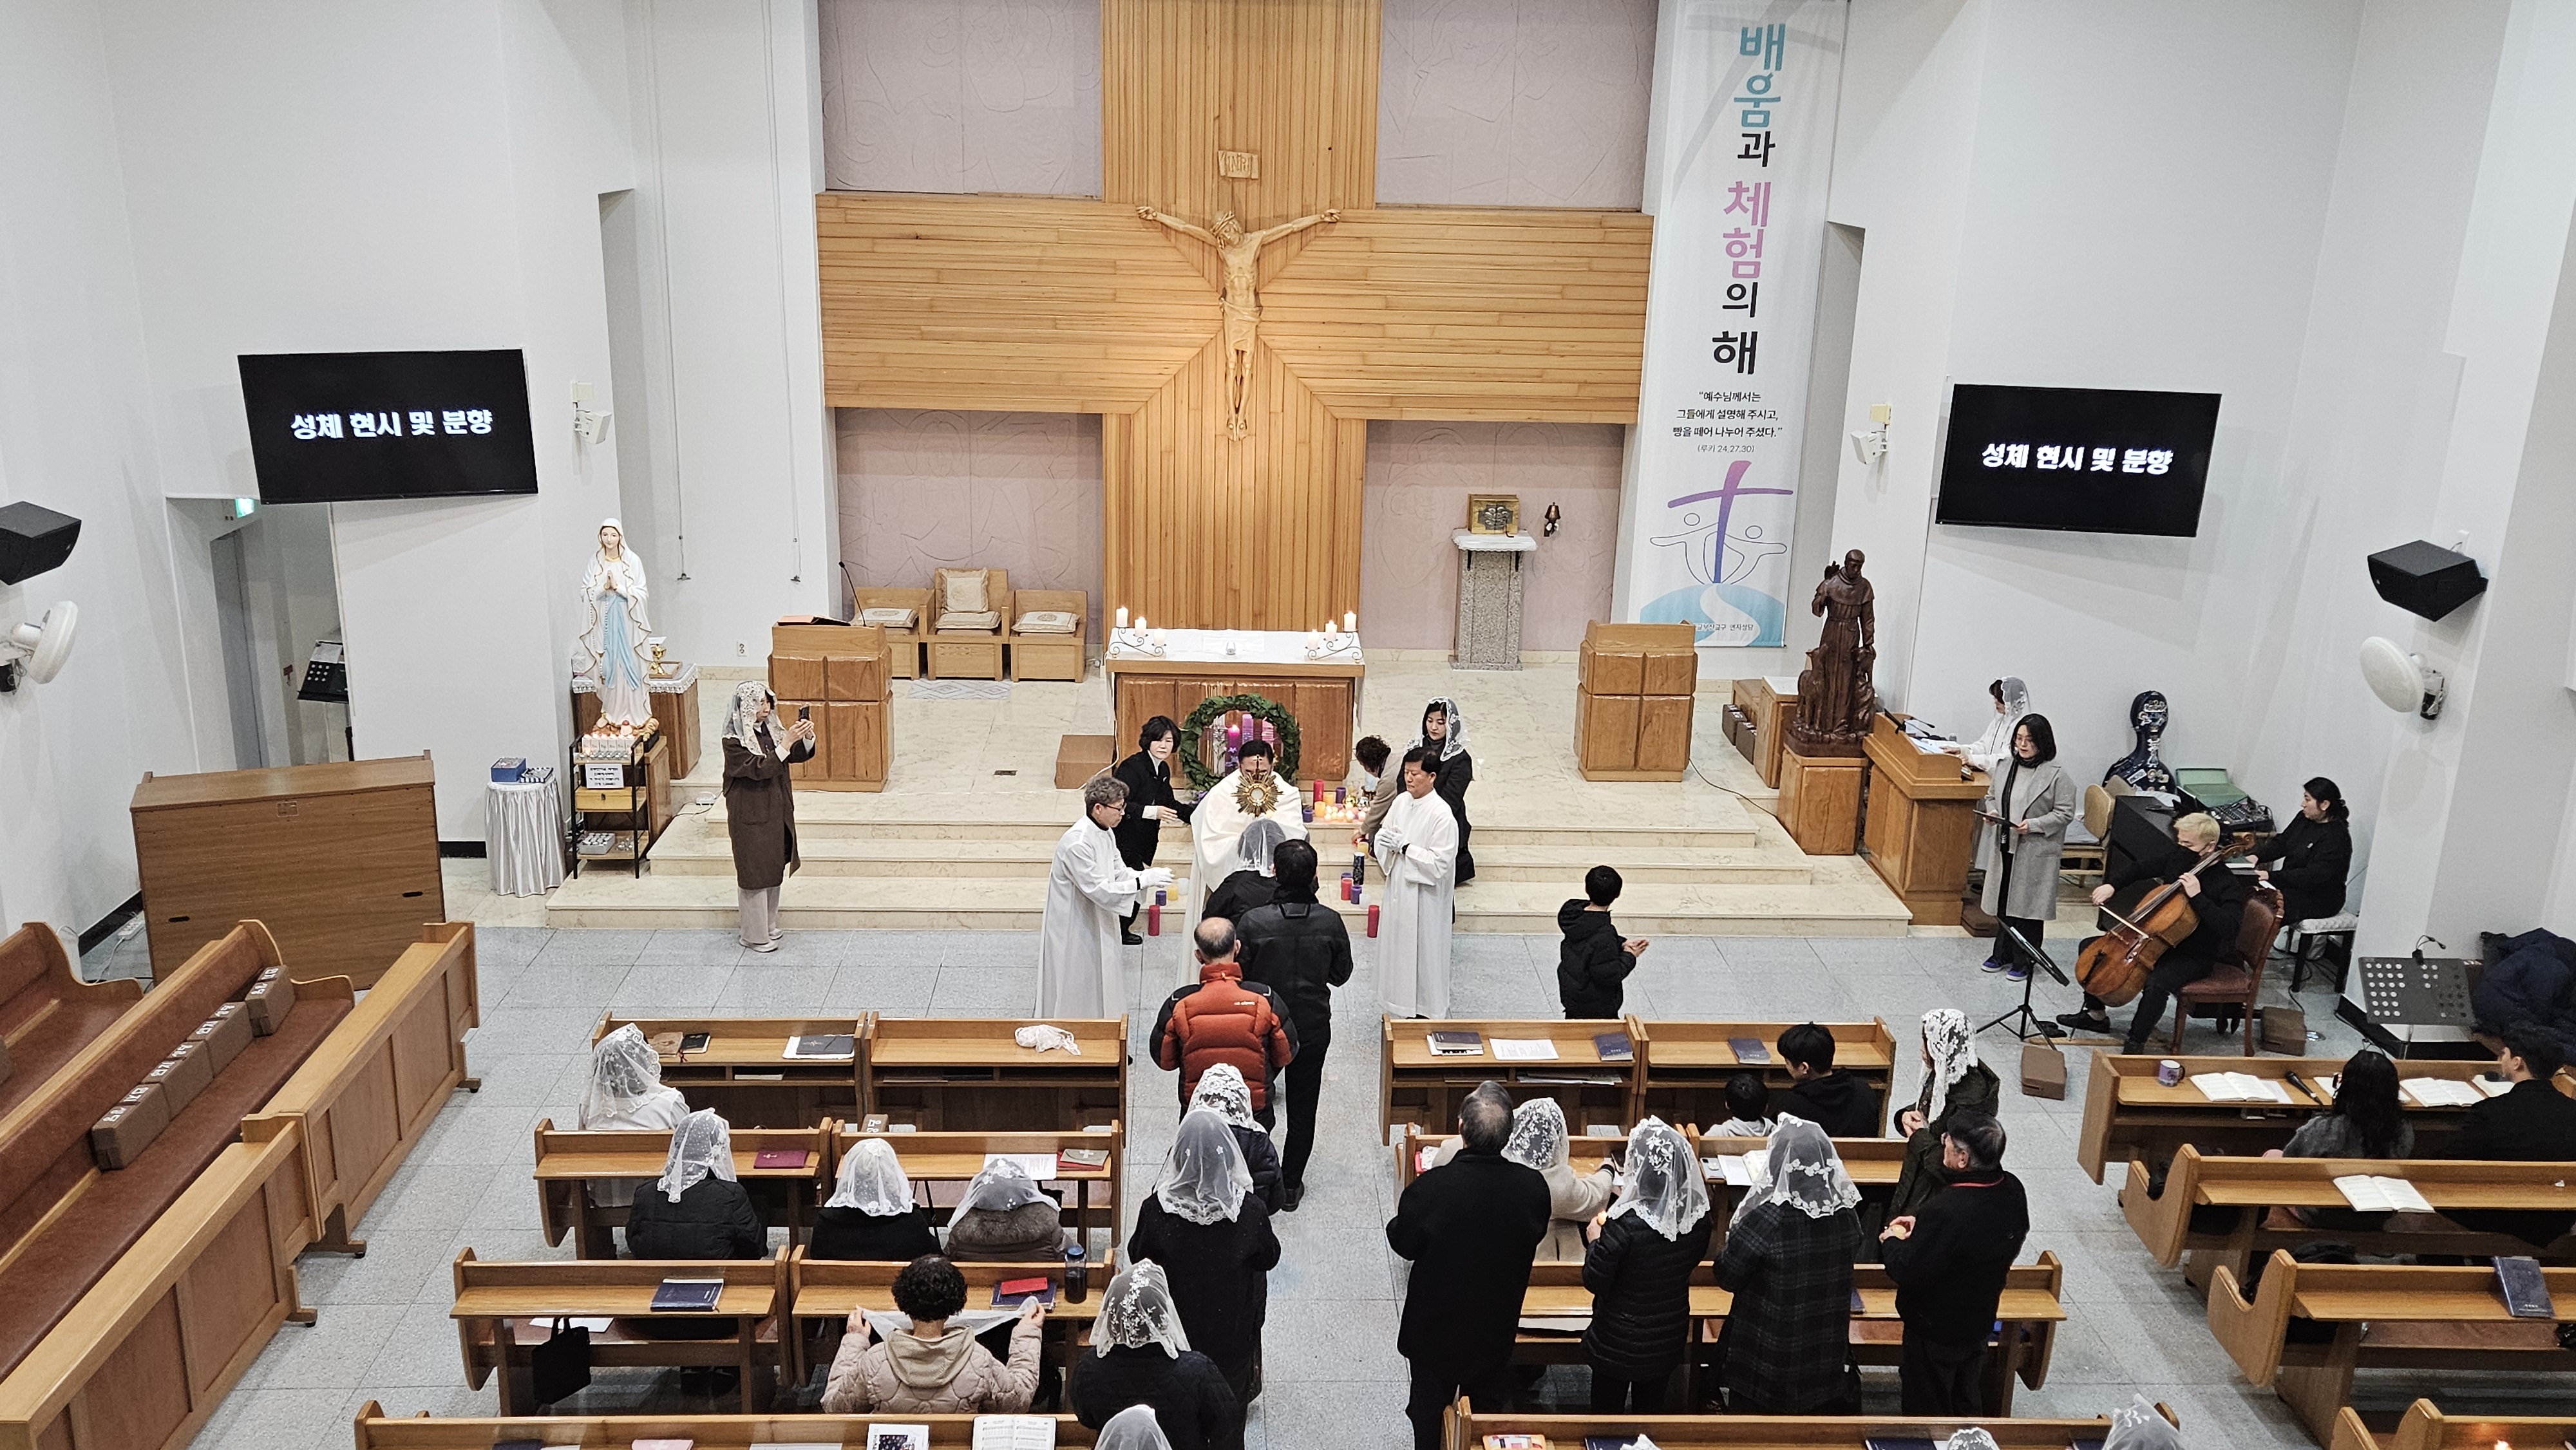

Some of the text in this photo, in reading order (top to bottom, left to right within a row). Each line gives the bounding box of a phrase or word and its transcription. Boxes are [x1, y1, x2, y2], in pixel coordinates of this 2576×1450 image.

[1712, 23, 1786, 375] 배움과 체험의 해
[290, 409, 493, 440] 성체 현시 및 분향
[1676, 409, 1779, 421] 그들에게 설명해 주시고,
[1672, 426, 1692, 437] 빵을
[1694, 426, 1713, 437] 떼어
[1715, 426, 1744, 437] 나누어
[1982, 442, 2174, 475] 성체 현시 및 분향
